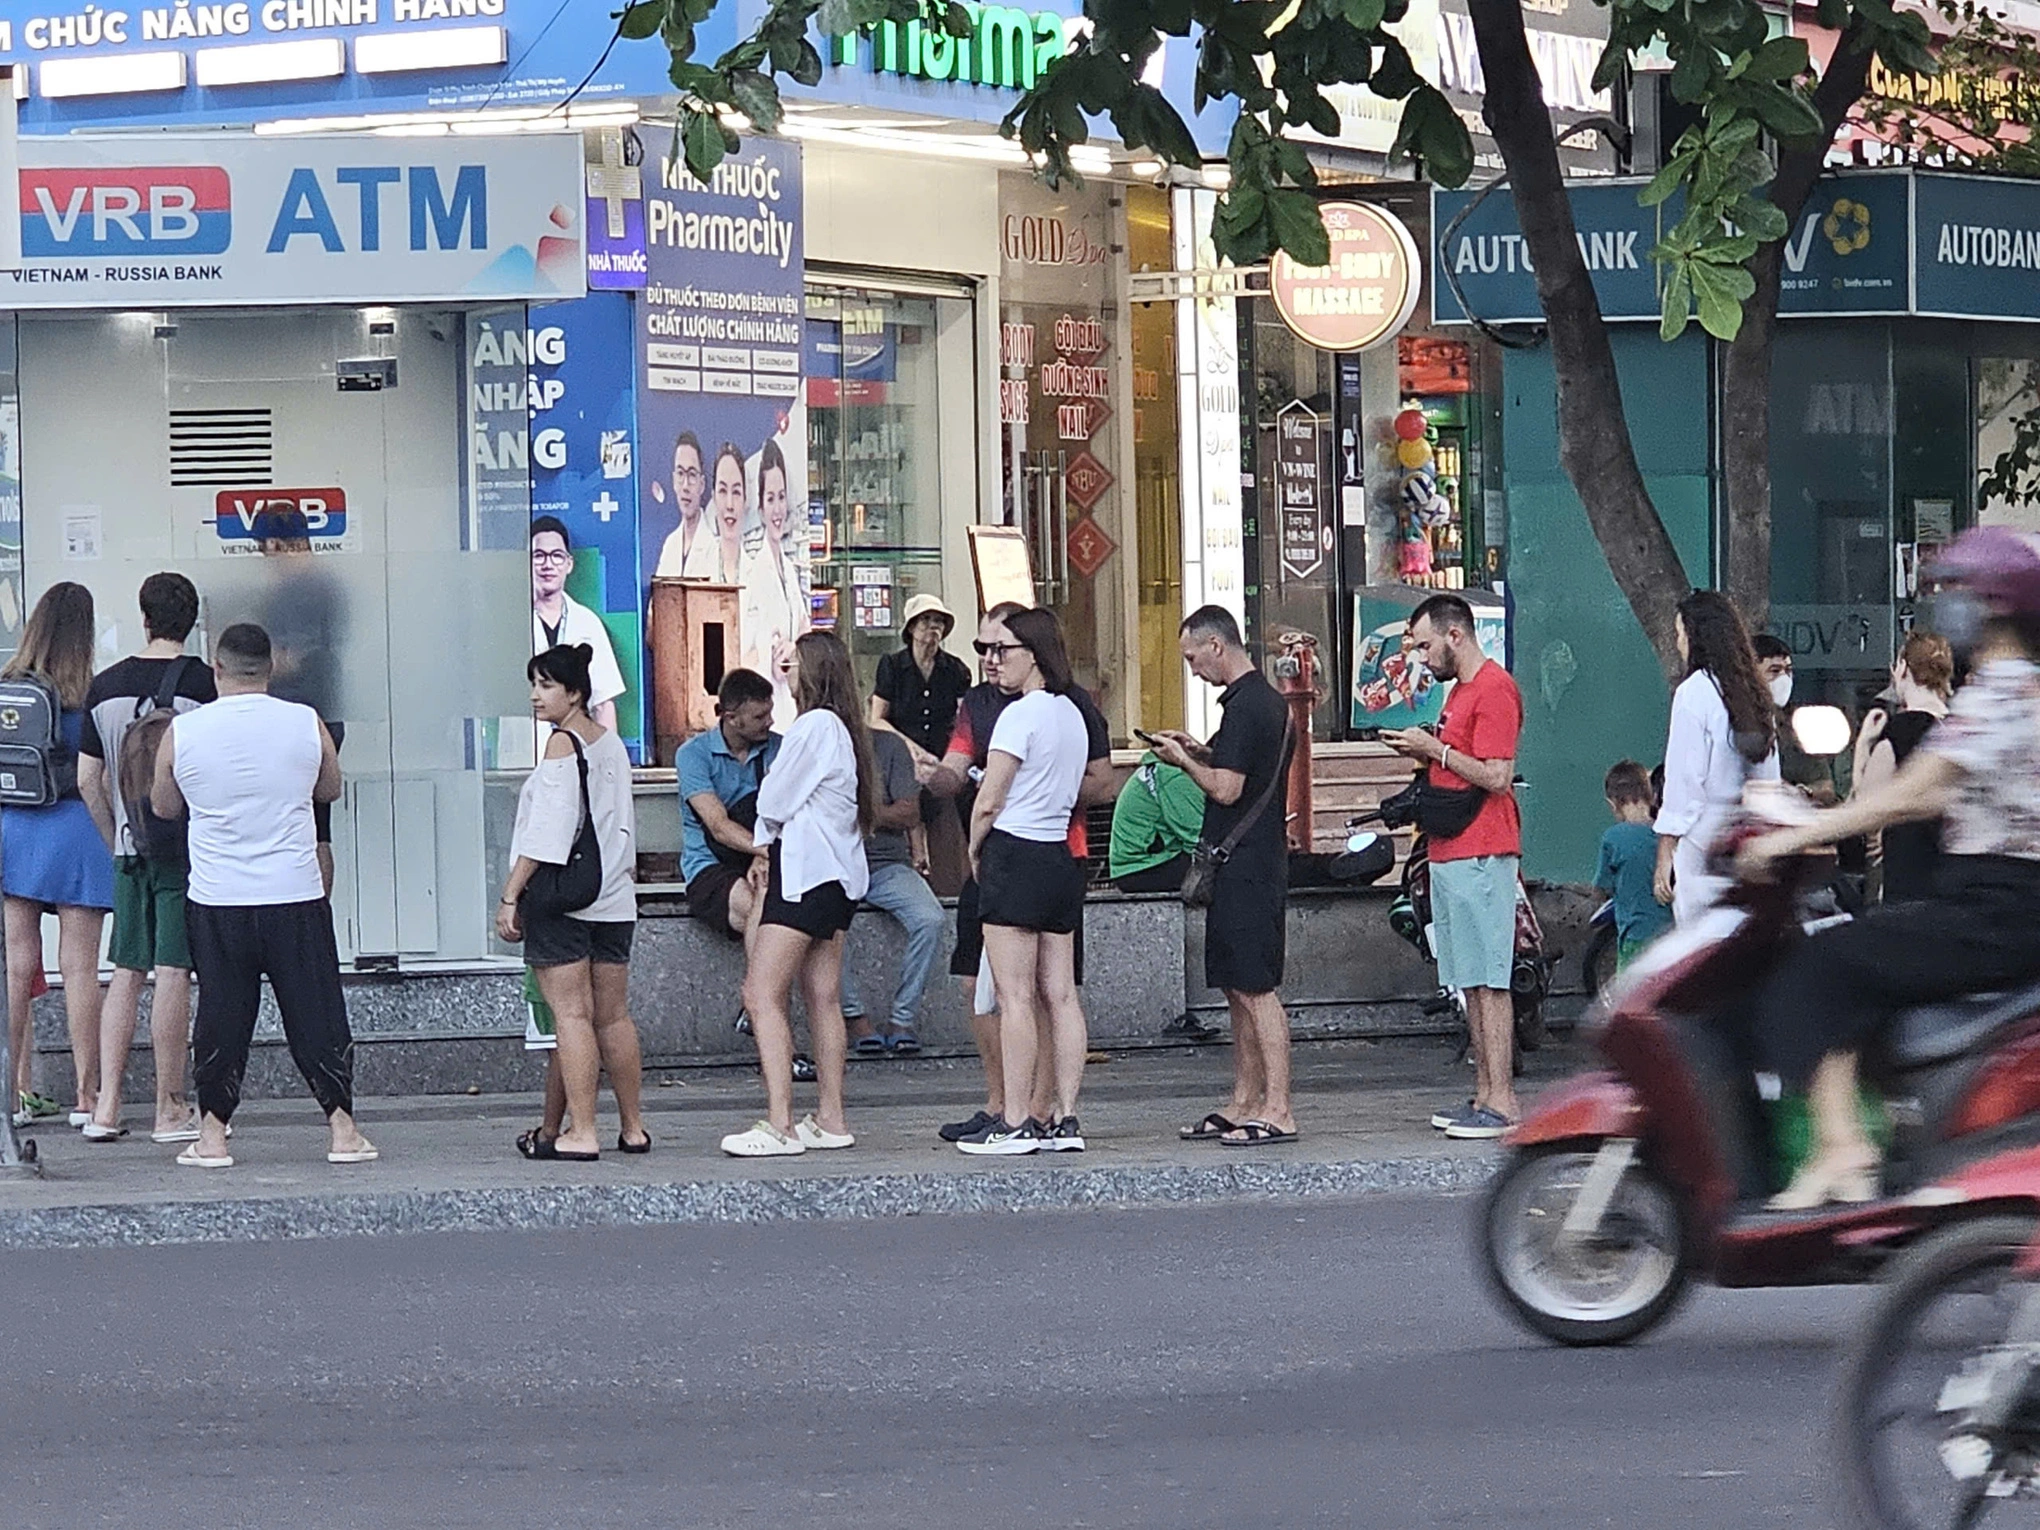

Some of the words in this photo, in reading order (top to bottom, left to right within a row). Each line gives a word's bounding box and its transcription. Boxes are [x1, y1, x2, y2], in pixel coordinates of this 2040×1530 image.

[24, 5, 128, 49] CHỨC
[142, 0, 250, 40] NĂNG
[712, 156, 780, 200] THUỐC
[34, 186, 199, 242] VRB
[266, 165, 487, 253] ATM
[650, 200, 793, 268] Pharmacity
[1004, 213, 1064, 265] GOLD
[1455, 231, 1638, 274] AUTNK
[12, 268, 89, 283] VIETNAM
[105, 267, 169, 281] RUSSIA
[175, 266, 222, 280] BANK
[589, 251, 611, 272] NHÀ
[612, 250, 647, 272] THUỐC
[647, 281, 662, 304] ĐỦ
[664, 284, 699, 307] THUỐC
[700, 291, 727, 309] THEO
[751, 291, 776, 317] BỆNH
[777, 293, 798, 318] VIỆN
[1293, 287, 1384, 315] MASSAGE
[648, 309, 681, 336] CHẤT
[683, 315, 725, 343] LƯỢNG
[727, 316, 764, 342] CHÍNH
[766, 318, 799, 344] HÃNG
[1003, 323, 1034, 367] BODY
[474, 374, 564, 418] NHẬP
[1202, 385, 1236, 413] GOLD
[1058, 405, 1088, 440] NAIL
[234, 498, 328, 531] VB
[315, 542, 342, 552] BANK
